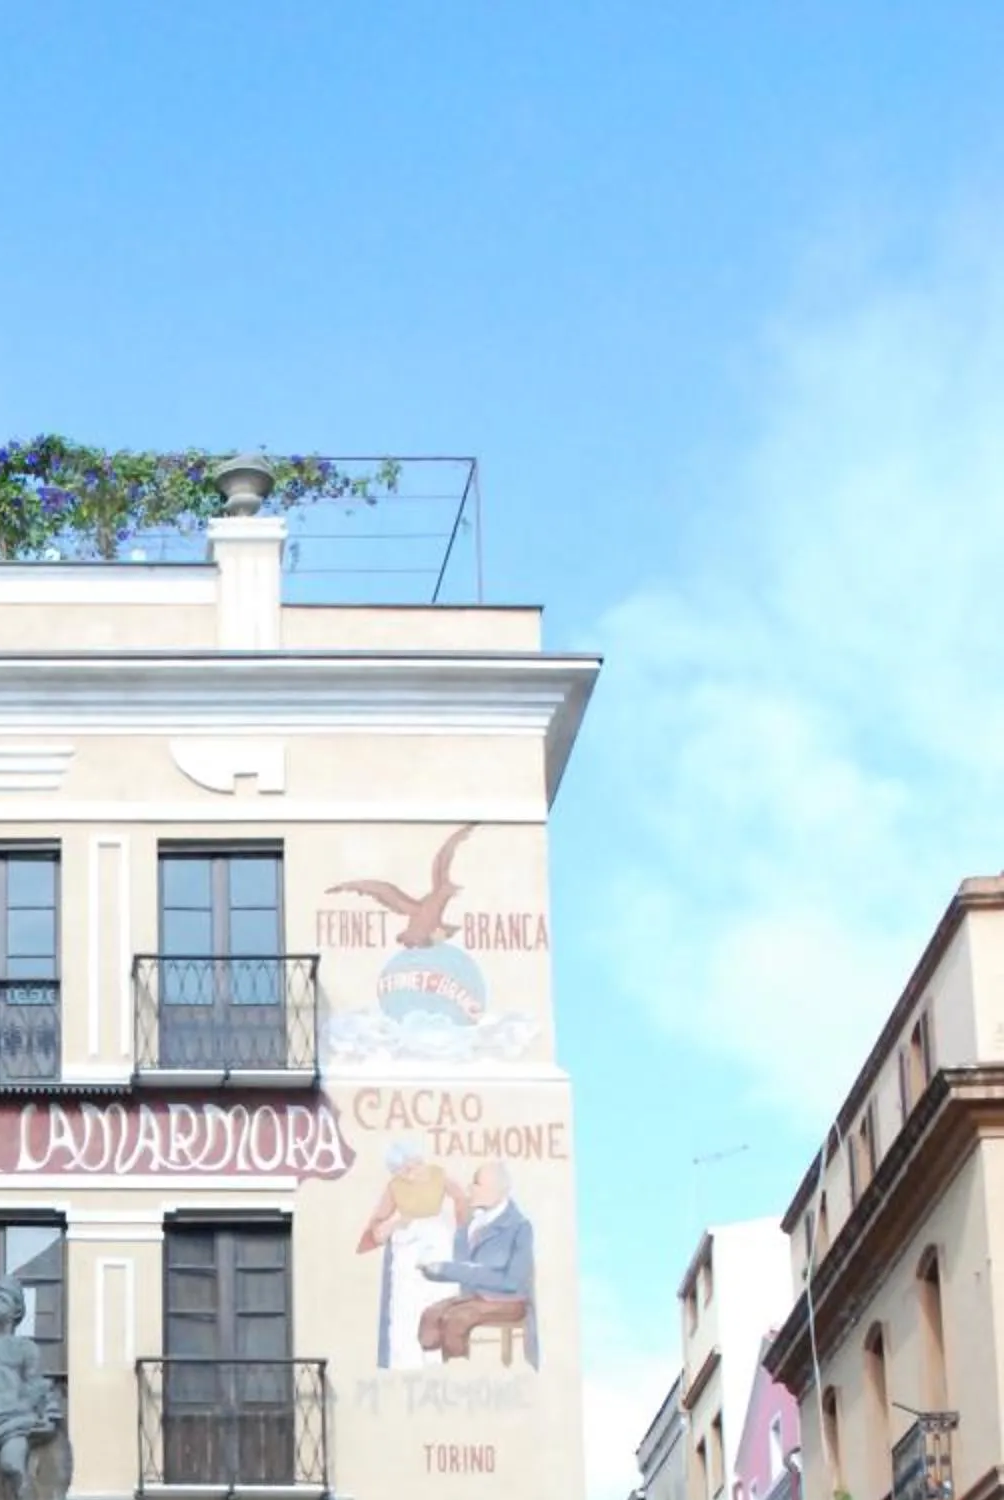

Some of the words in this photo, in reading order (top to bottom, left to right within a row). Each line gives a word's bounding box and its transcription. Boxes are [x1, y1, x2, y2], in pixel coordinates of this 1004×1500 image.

[316, 911, 388, 948] FERNET
[464, 911, 549, 951] BRANCA
[353, 1086, 483, 1131] CACAO
[15, 1102, 354, 1174] LAMARMORA
[427, 1123, 568, 1161] TALMONE
[423, 1443, 495, 1473] TORINO
